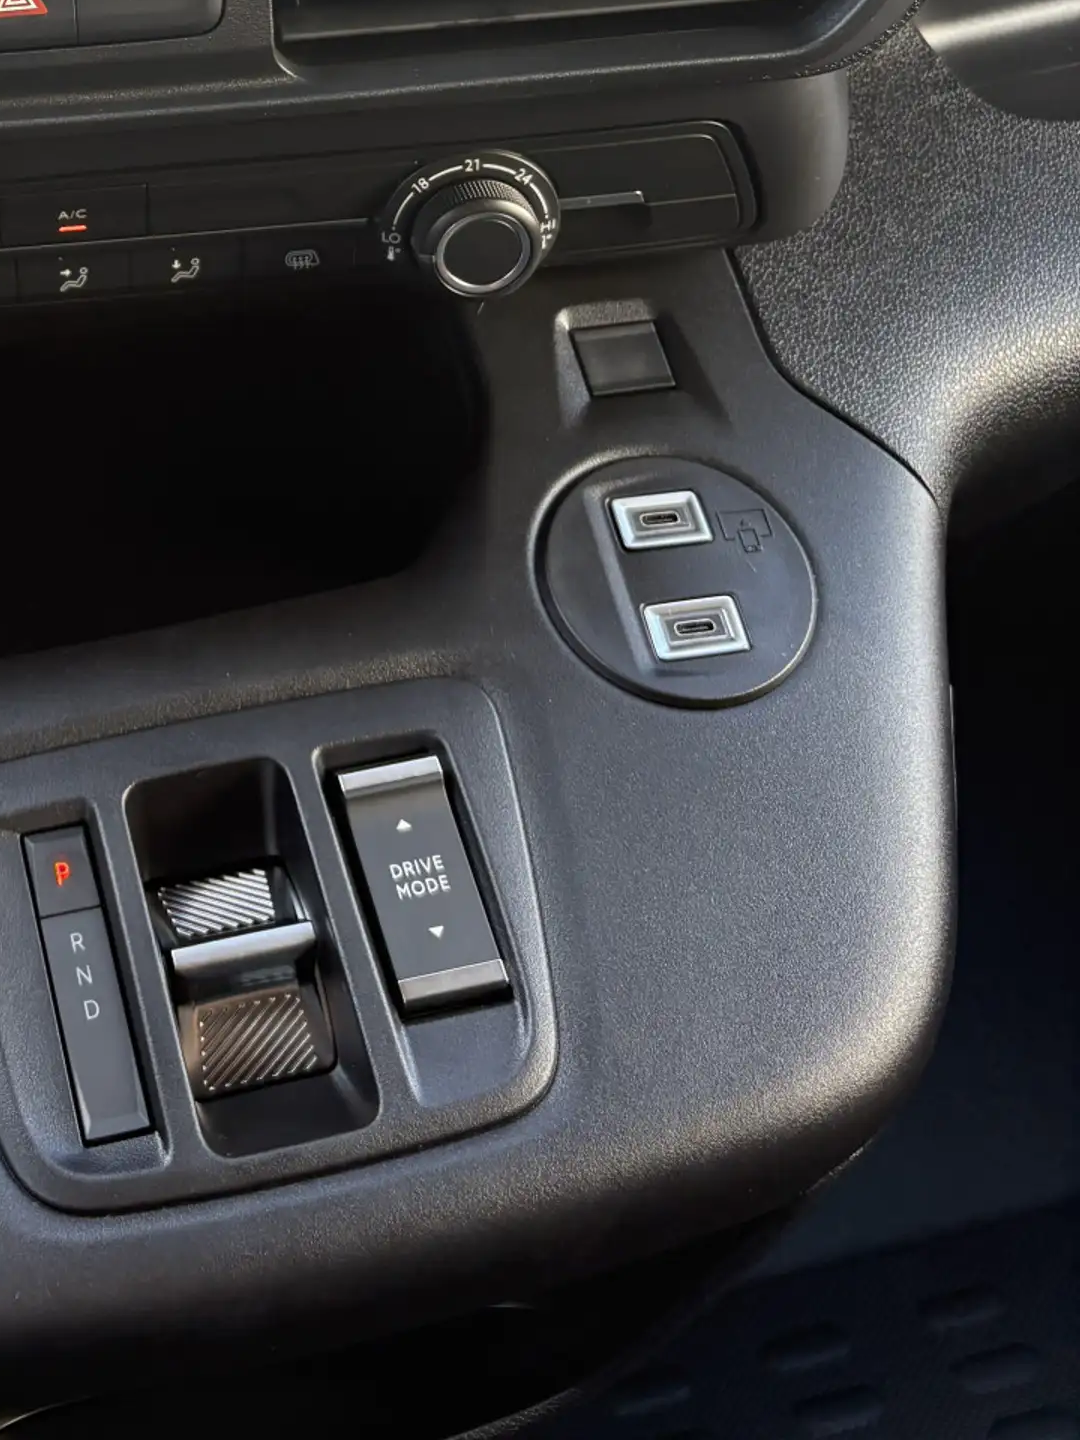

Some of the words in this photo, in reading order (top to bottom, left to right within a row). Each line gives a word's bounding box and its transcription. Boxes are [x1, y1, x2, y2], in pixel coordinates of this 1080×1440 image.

[464, 158, 480, 173] 21
[514, 167, 534, 186] 24
[411, 177, 431, 194] 18
[57, 208, 88, 221] A/C
[54, 860, 71, 887] P
[388, 854, 445, 881] DRIVE
[395, 872, 451, 901] MODE
[70, 931, 87, 953] R
[75, 963, 94, 988] N
[84, 998, 101, 1021] D
